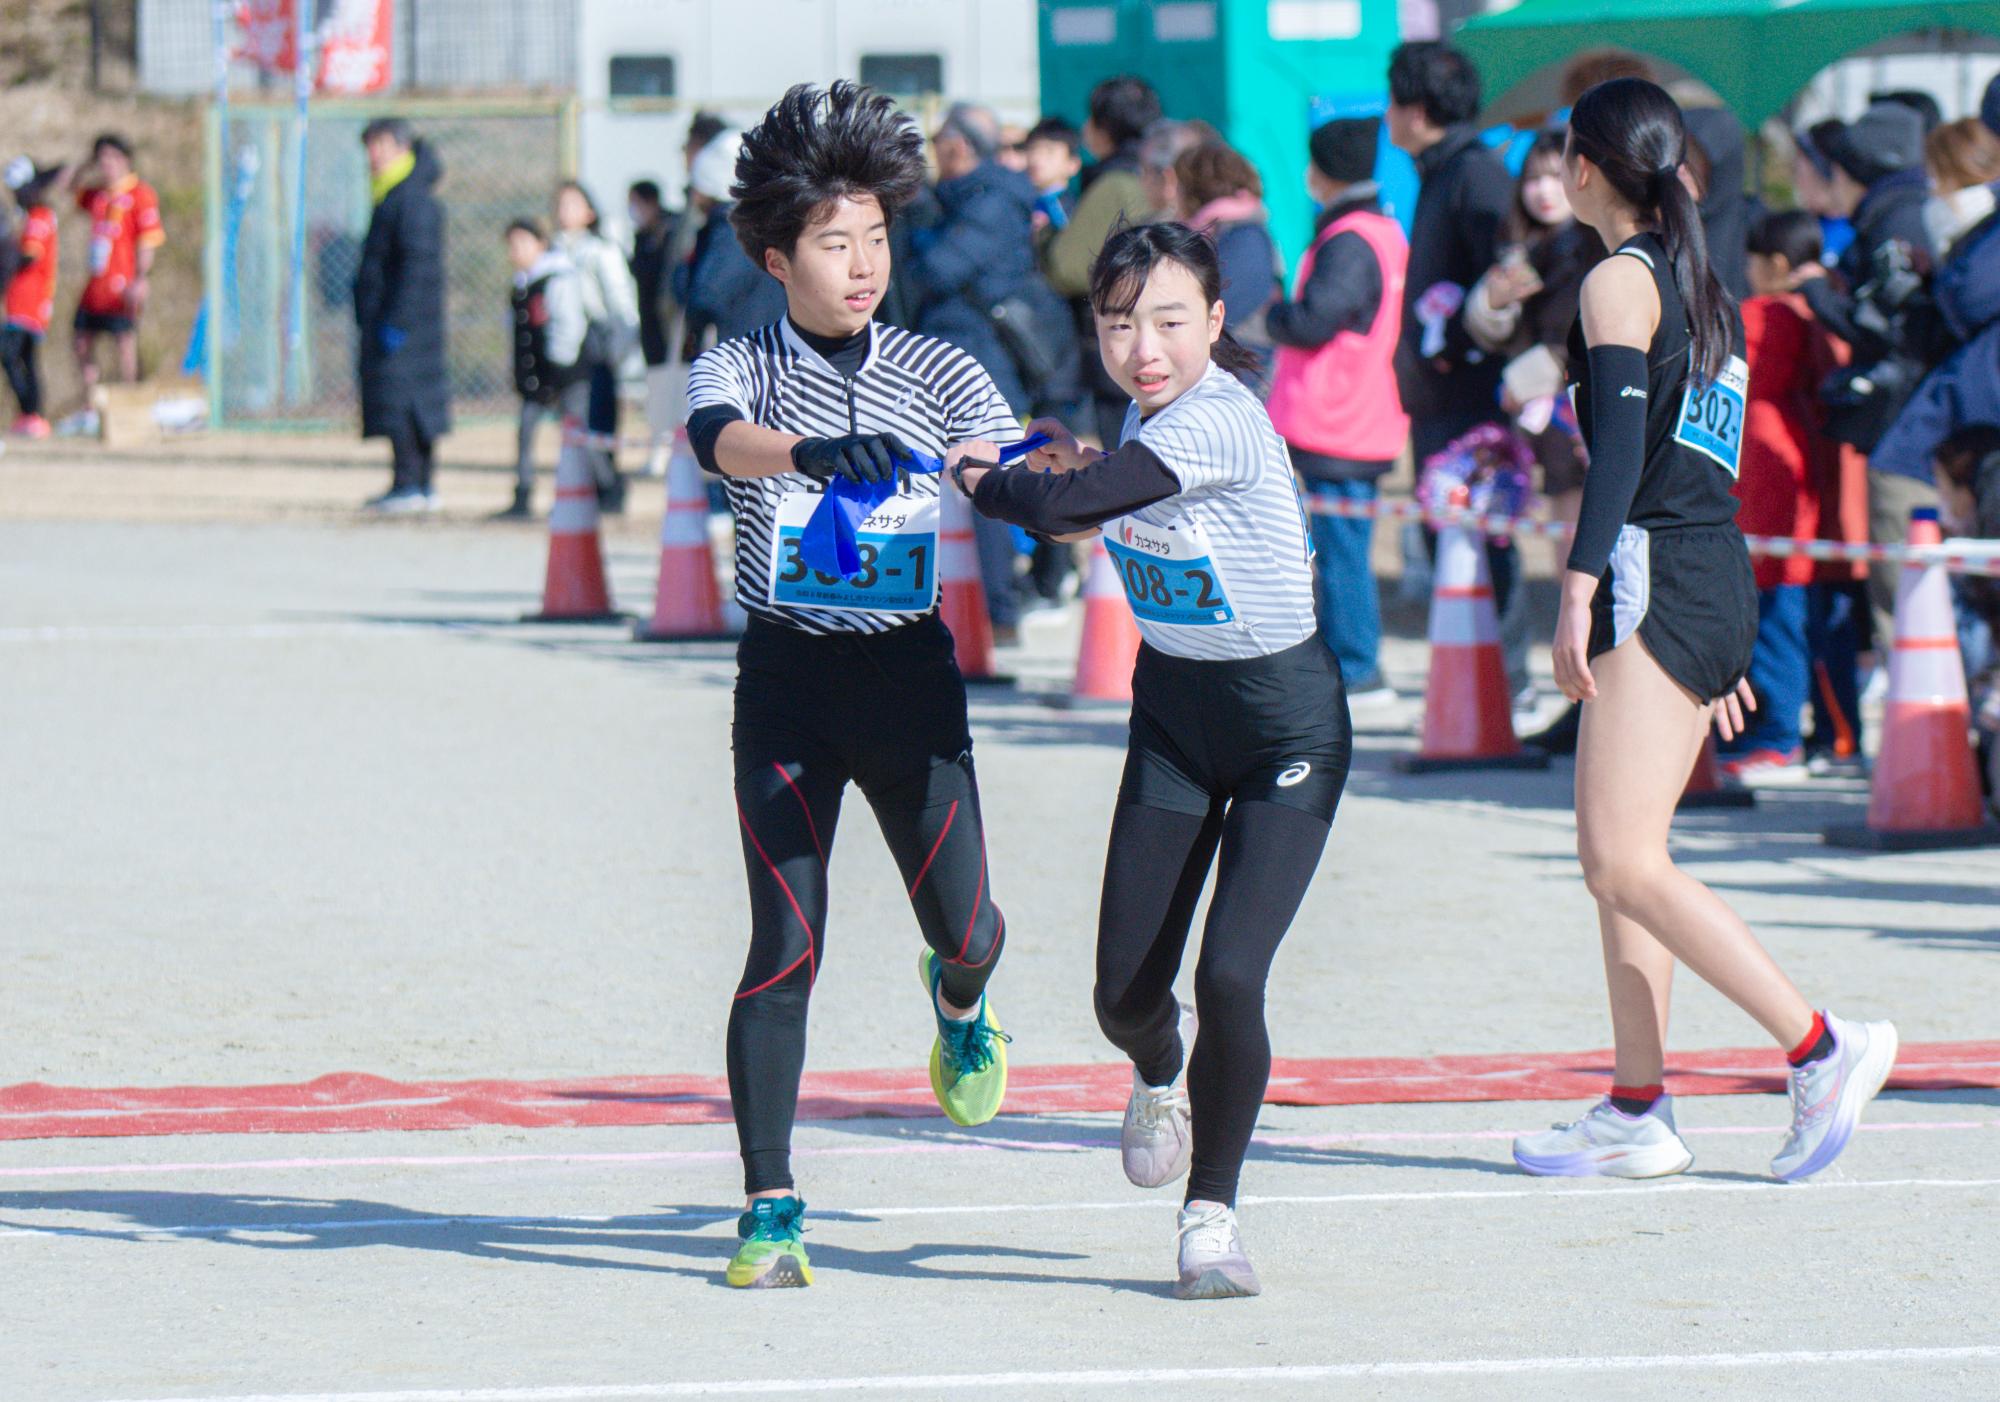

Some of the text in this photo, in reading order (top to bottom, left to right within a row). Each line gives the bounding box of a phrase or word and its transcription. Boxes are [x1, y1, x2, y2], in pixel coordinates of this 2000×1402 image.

[1686, 389, 1743, 451] 302-
[862, 514, 908, 530] ネサダ
[1134, 533, 1171, 555] カネサダ
[779, 537, 928, 592] 38-1
